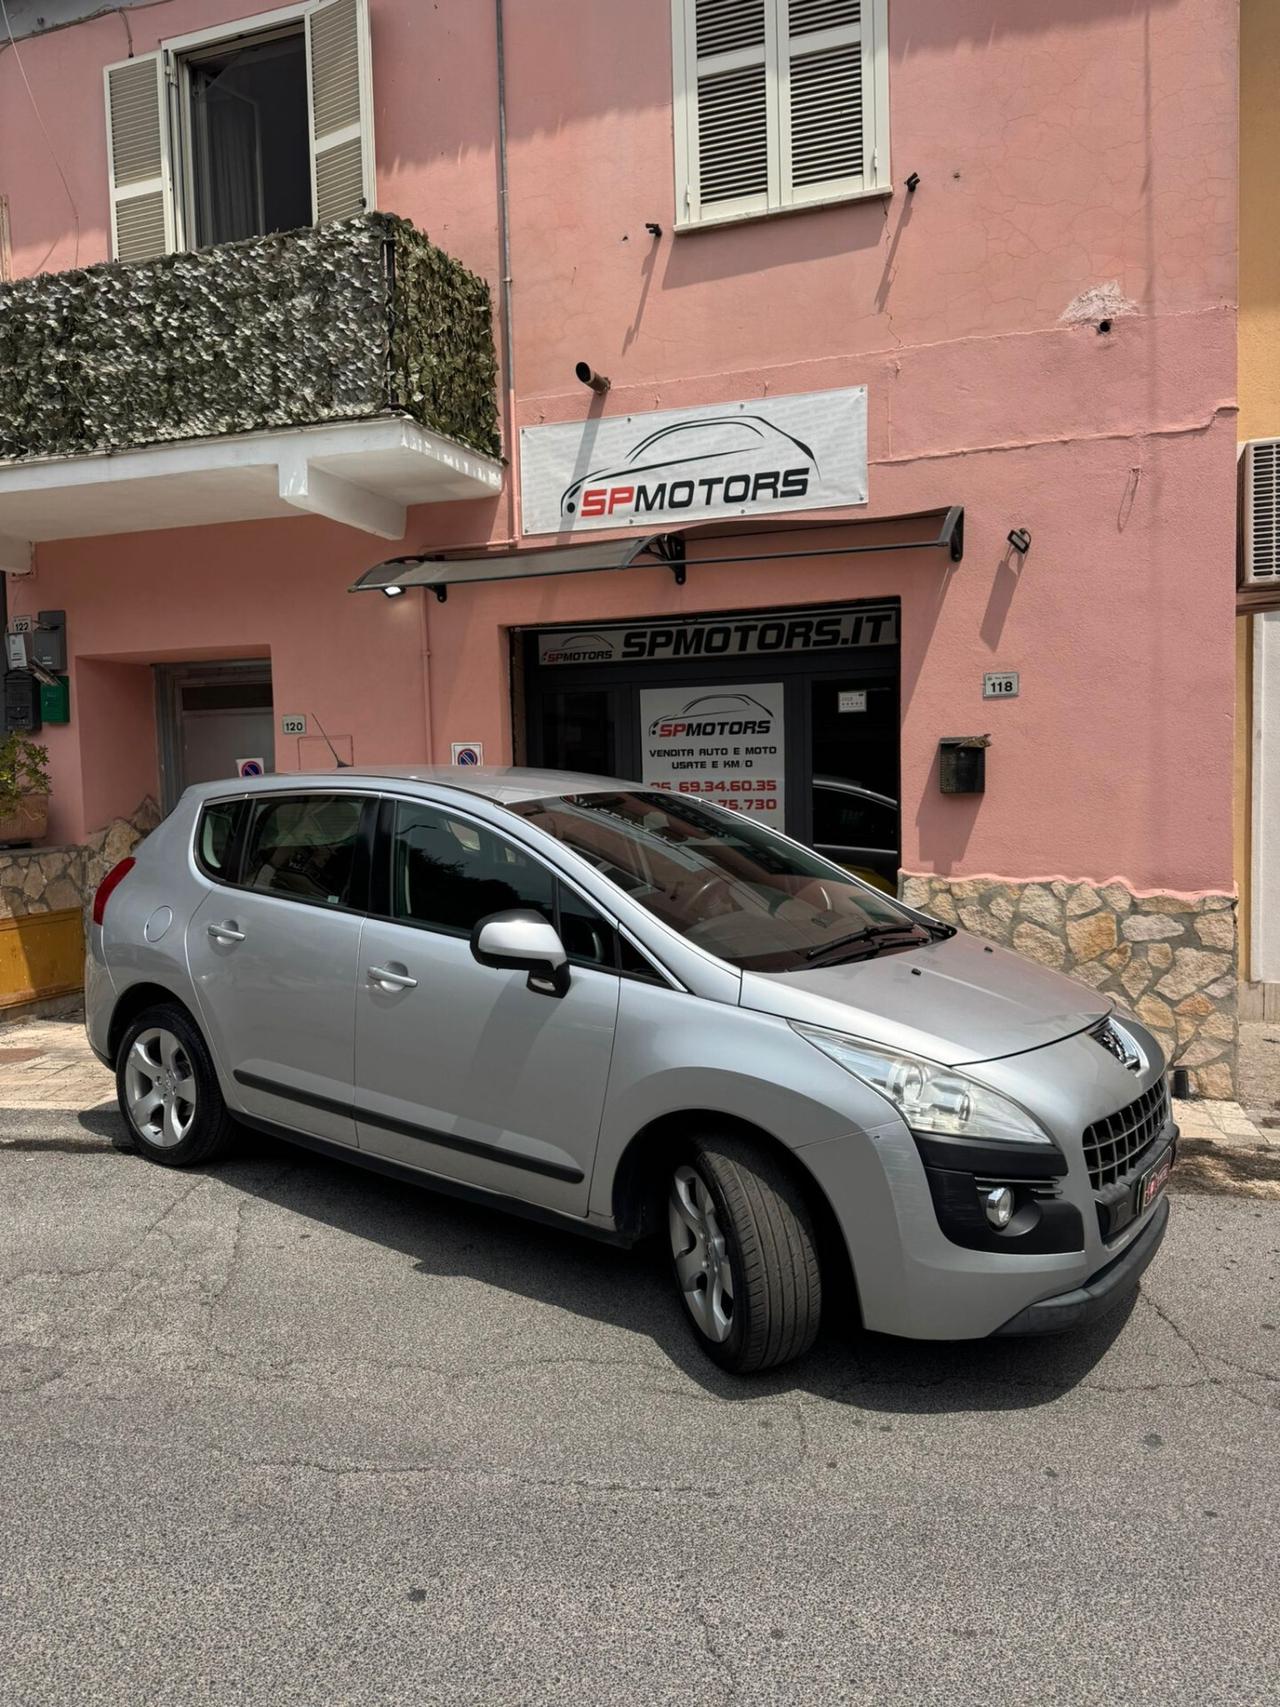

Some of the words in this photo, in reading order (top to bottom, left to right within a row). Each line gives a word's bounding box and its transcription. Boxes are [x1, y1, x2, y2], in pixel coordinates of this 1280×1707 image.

[580, 467, 809, 517] SPMOTORS
[621, 614, 892, 658] SPMOTORS.IT
[547, 650, 613, 663] SPMOTORS
[990, 681, 1013, 693] 118
[285, 722, 303, 731] 120
[659, 720, 771, 738] SPMOTORS
[649, 748, 695, 757] VENDITA
[699, 747, 728, 756] AUTO
[733, 747, 741, 755] E
[745, 746, 777, 754] MOTO
[671, 761, 707, 769] USATE
[711, 760, 719, 768] E
[679, 780, 777, 792] 69.34.60.35
[708, 799, 777, 810] 75.730
